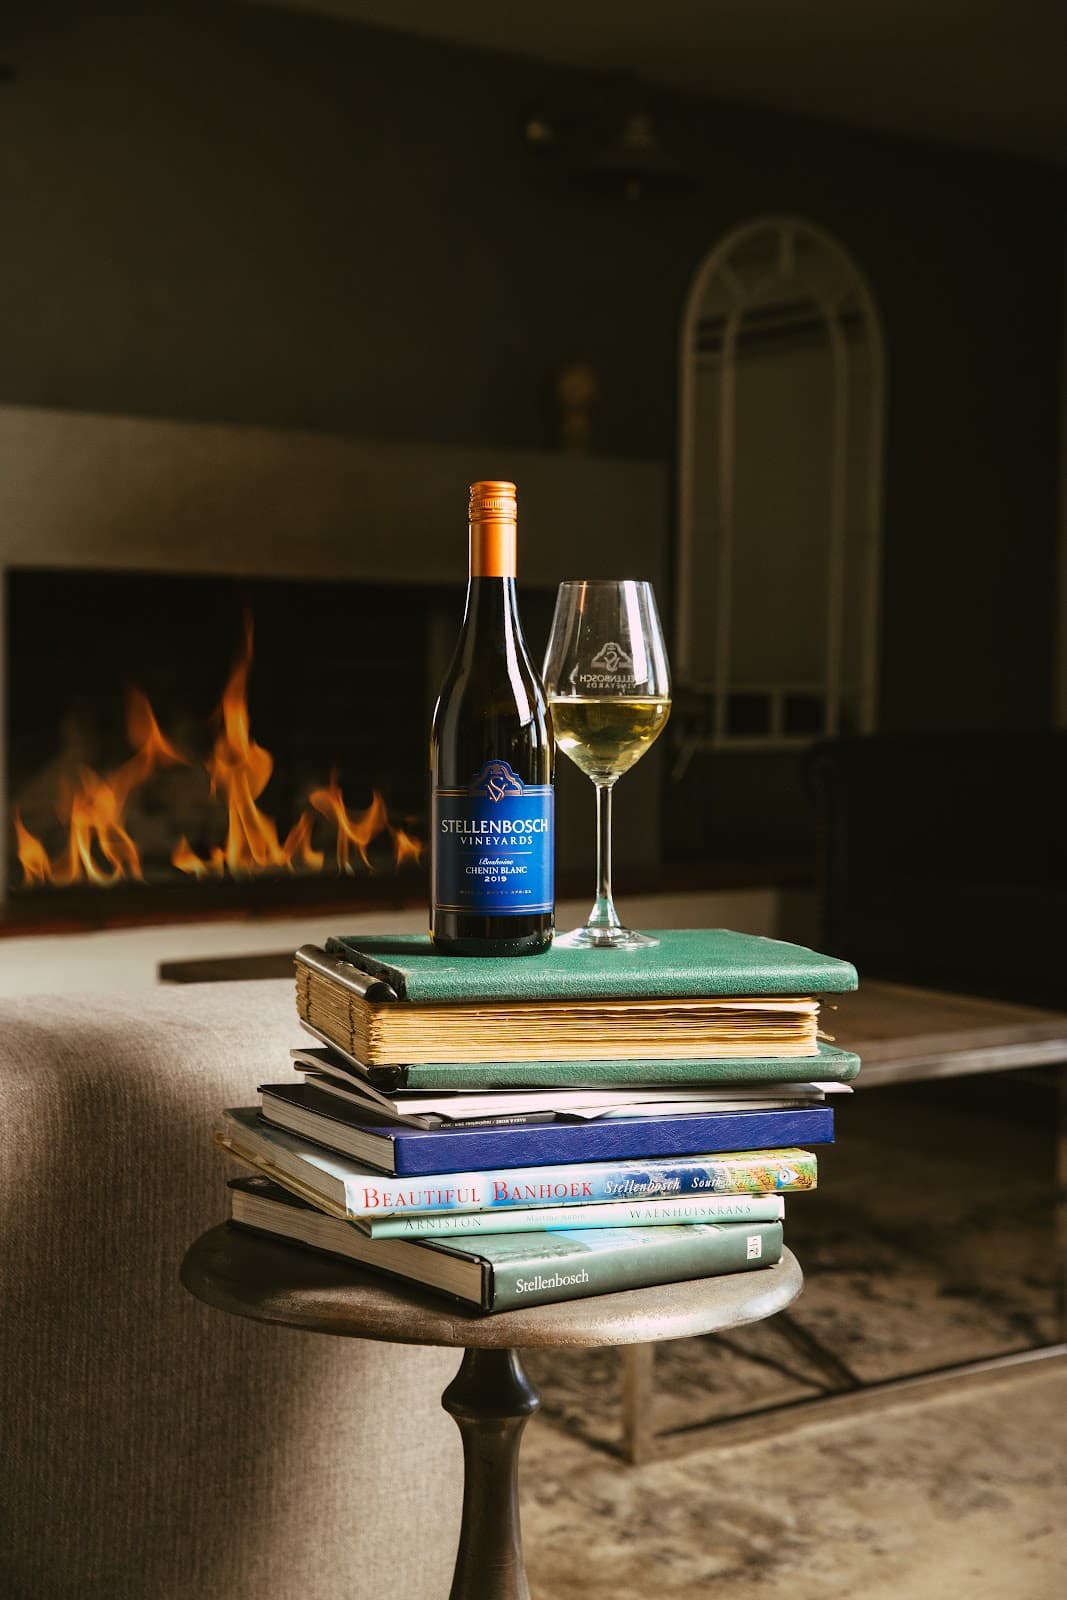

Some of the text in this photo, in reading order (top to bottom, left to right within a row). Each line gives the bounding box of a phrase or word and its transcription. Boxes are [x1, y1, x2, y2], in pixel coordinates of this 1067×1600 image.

[441, 819, 548, 834] STELLENBOSCH
[460, 836, 533, 846] VINEYARDS
[465, 866, 528, 874] CHENIN BLANC
[604, 1177, 681, 1194] Stellenbosch
[691, 1174, 721, 1188] South
[362, 1181, 593, 1208] BEAUTIFUL BANHOEK
[629, 1206, 752, 1219] WAENHUISKRANS
[404, 1216, 482, 1231] ARNISTON
[515, 1268, 589, 1294] Stellenbosch
